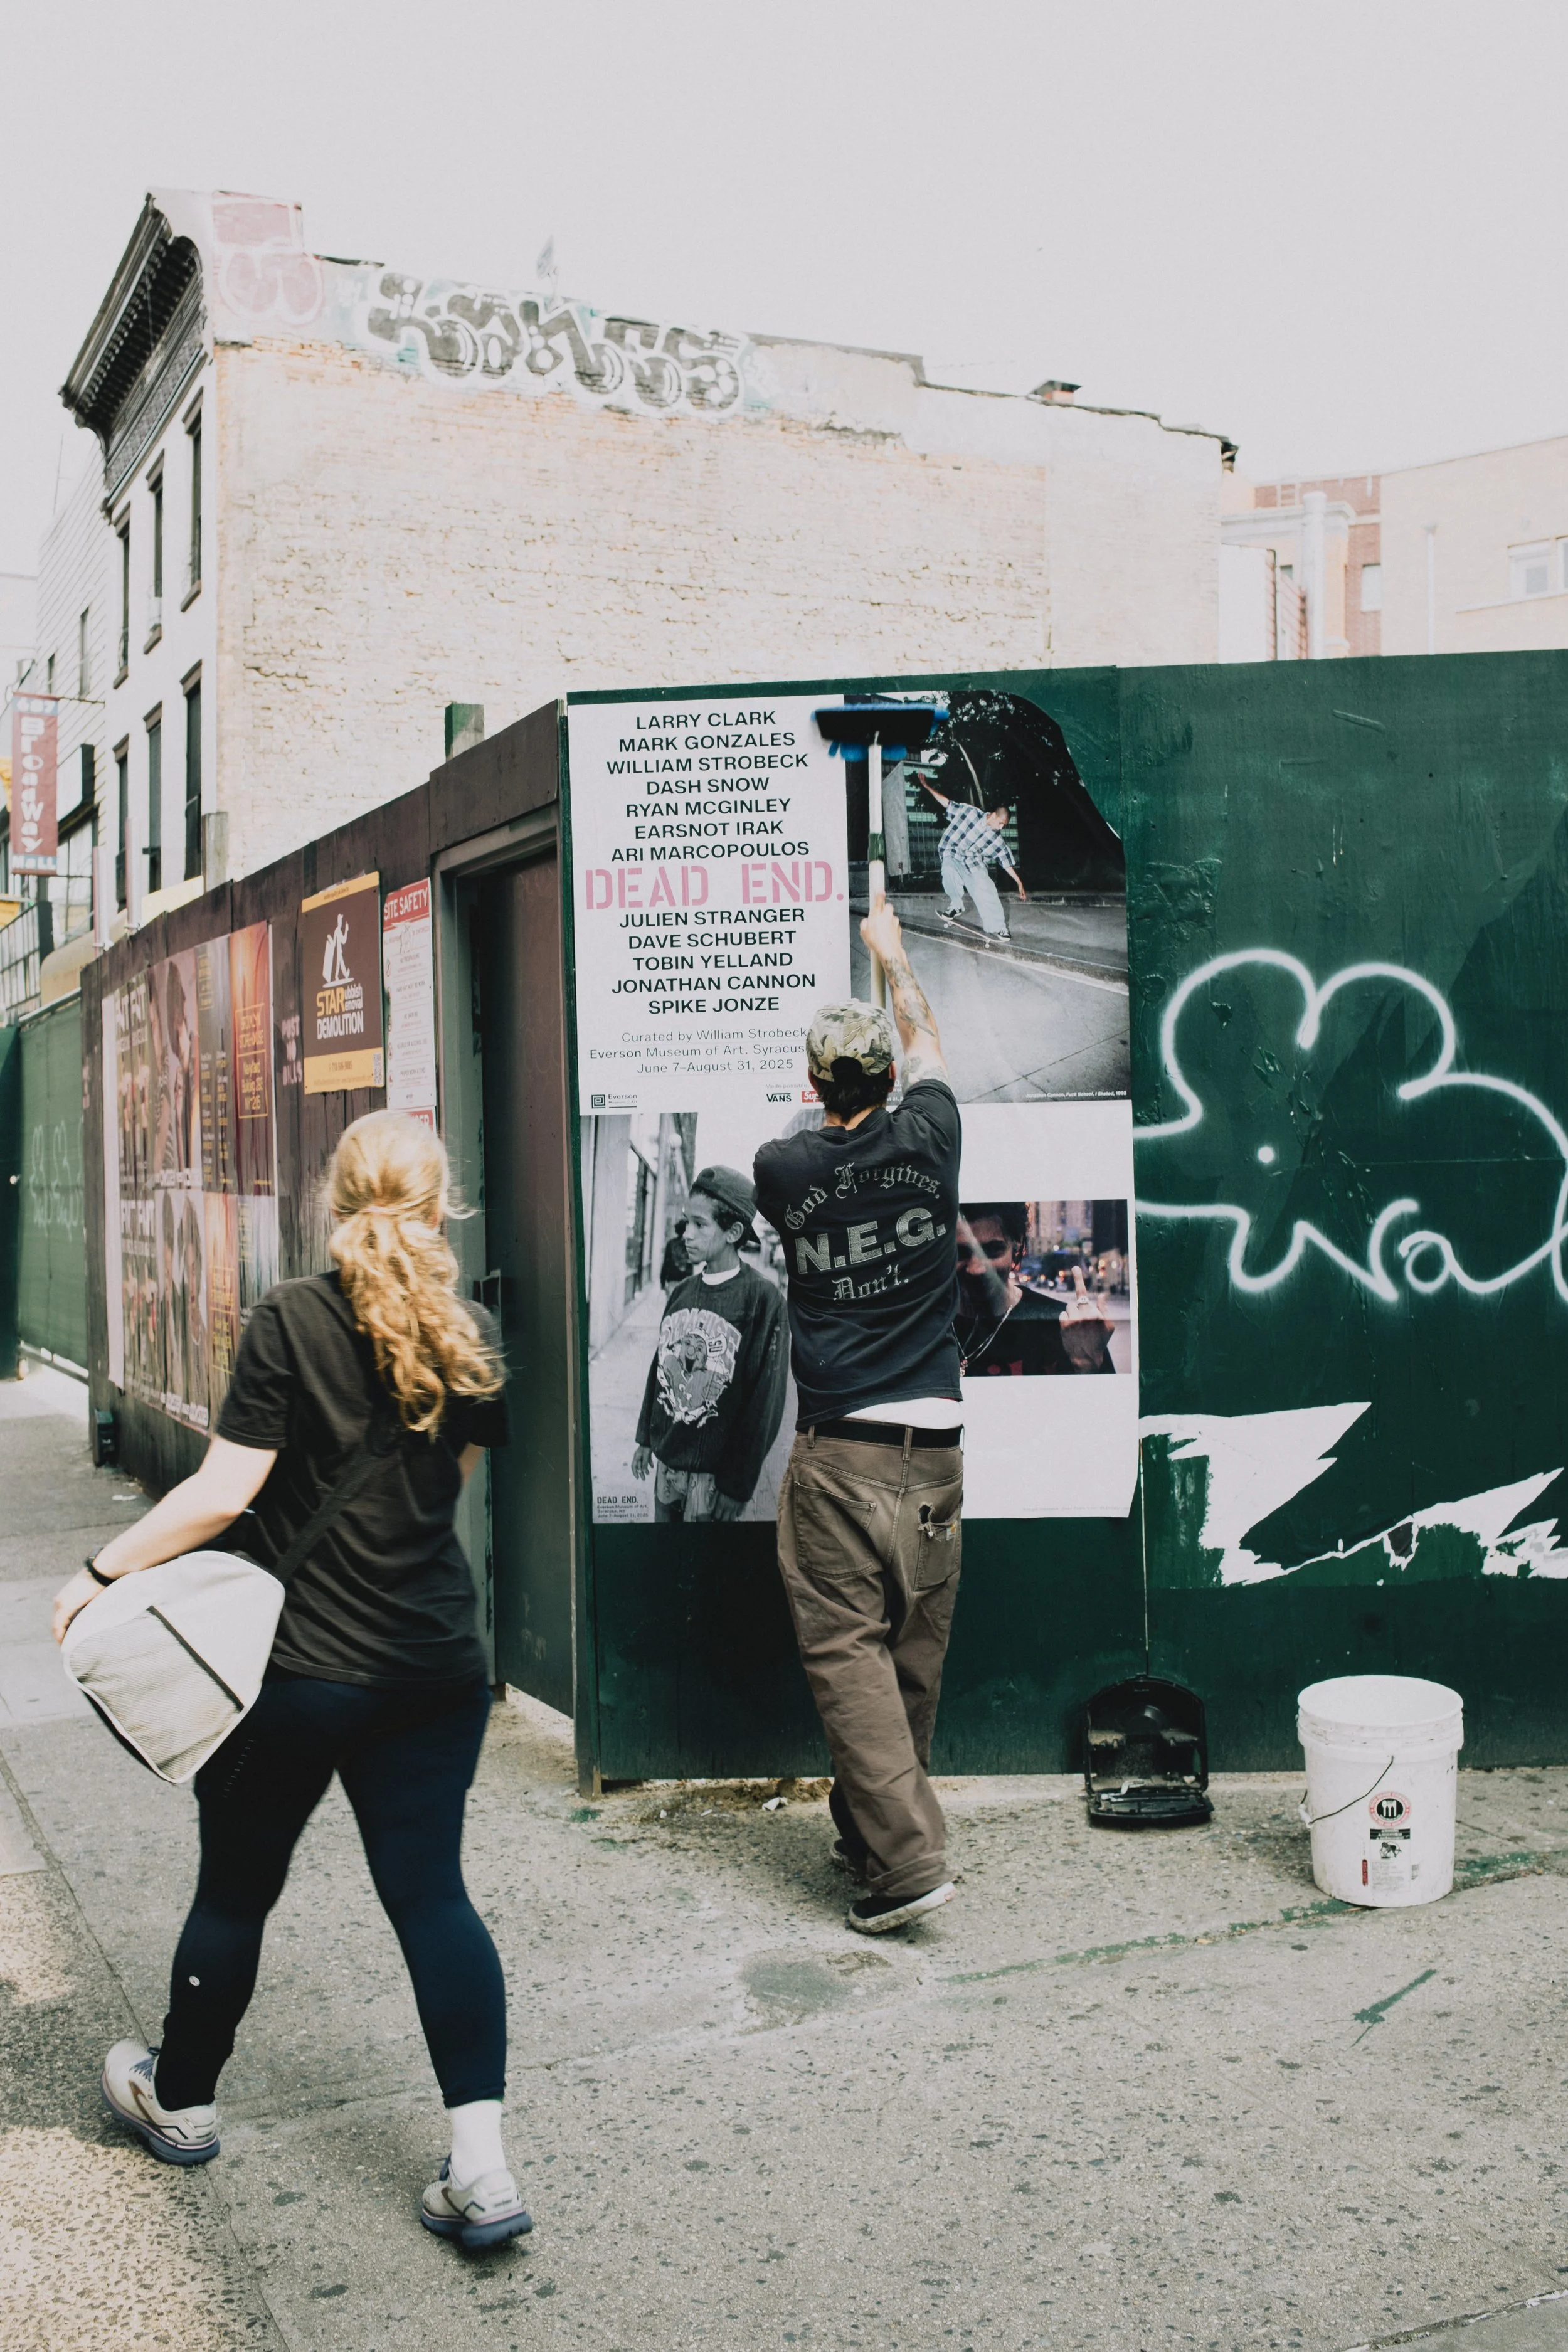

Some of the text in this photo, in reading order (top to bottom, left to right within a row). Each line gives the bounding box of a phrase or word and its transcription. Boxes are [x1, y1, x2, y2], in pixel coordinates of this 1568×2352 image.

[637, 711, 775, 729] LARRY CLARK
[620, 733, 795, 752] MARK GONZALES
[607, 754, 808, 774] WILLIAM STROBECK
[647, 777, 769, 795] DASH SNOW
[627, 798, 790, 817] RYAN MCGINLEY
[635, 820, 783, 839] EARSNOT IRAK
[612, 842, 809, 862] ARI MARCOPOULOS
[586, 861, 844, 909] DEAD END.
[383, 887, 428, 921] SITE SAFETY
[620, 909, 804, 928] JULIEN STRANGER
[629, 931, 796, 949] DAVE SCHUBERT
[633, 953, 792, 970] TOBIN YELLAND
[612, 974, 815, 993] JONATHAN CANNON
[317, 987, 344, 1017] STAR
[649, 997, 779, 1014] SPIKE JONZE
[317, 1011, 363, 1040] DEMOLITION
[622, 1027, 807, 1042] Curated by William Strobeck
[590, 1050, 641, 1059] Everson
[647, 1048, 700, 1057] Museum
[706, 1047, 716, 1055] of
[753, 1044, 805, 1056] Syracus
[637, 1064, 667, 1073] June
[737, 1060, 755, 1071] 31,
[760, 1059, 793, 1069] 2025
[766, 1093, 792, 1103] VANS
[784, 1185, 828, 1229] God
[795, 1207, 948, 1274] N.E.G.
